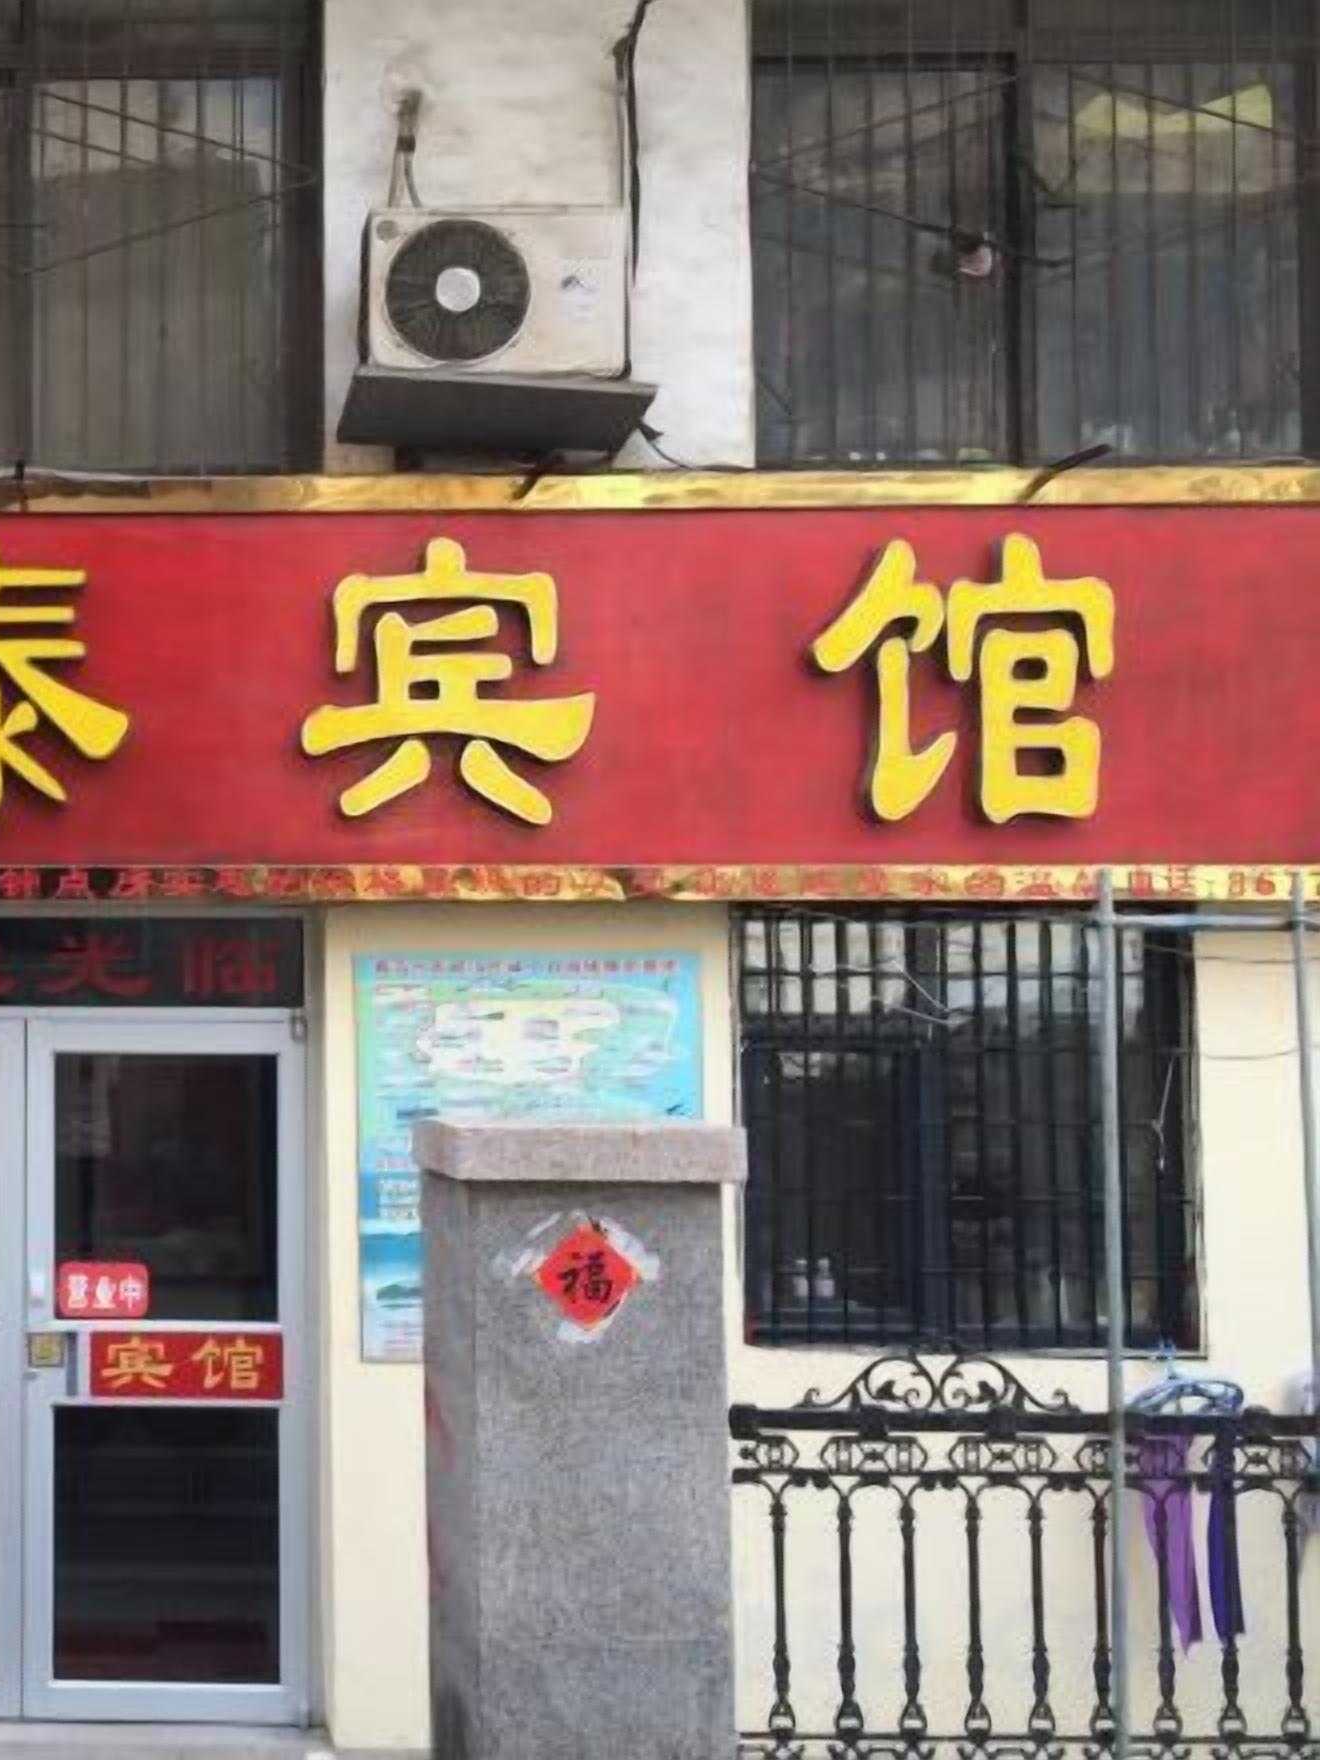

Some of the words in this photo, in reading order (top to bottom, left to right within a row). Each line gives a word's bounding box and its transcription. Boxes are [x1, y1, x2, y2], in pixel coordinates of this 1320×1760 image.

[65, 1274, 146, 1310] 营业中
[558, 1252, 614, 1304] 福
[100, 1335, 264, 1391] 宾馆
